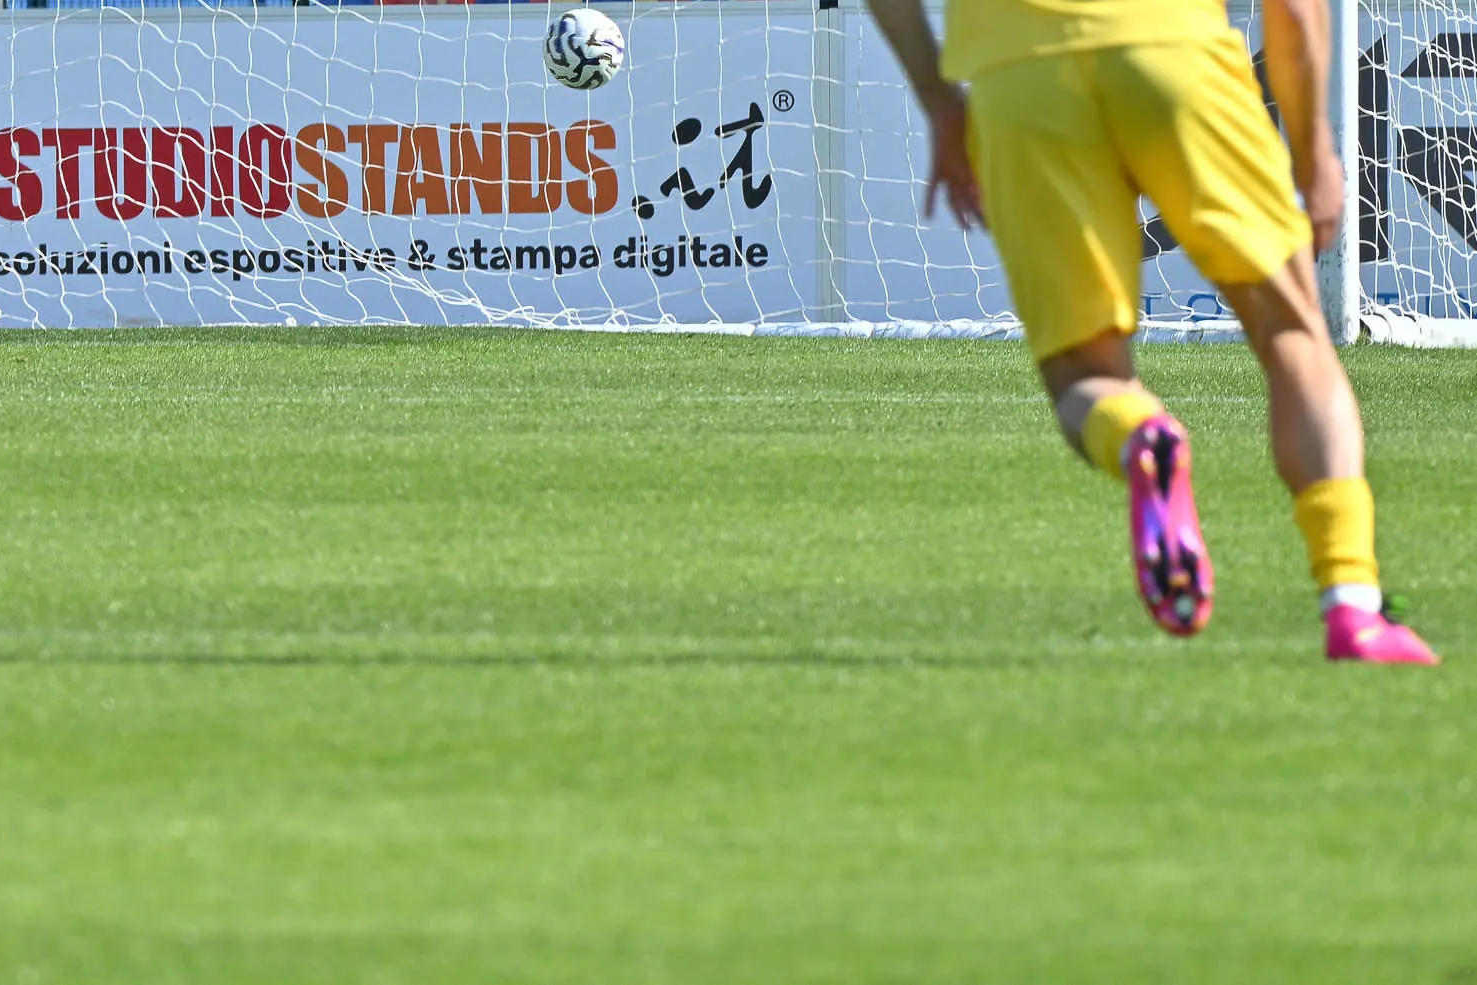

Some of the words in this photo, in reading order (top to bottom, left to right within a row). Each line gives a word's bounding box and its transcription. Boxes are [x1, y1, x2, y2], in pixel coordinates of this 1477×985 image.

[184, 239, 396, 281] espositive
[407, 238, 437, 271] &
[446, 238, 601, 279] stampa
[613, 235, 769, 278] digitale
